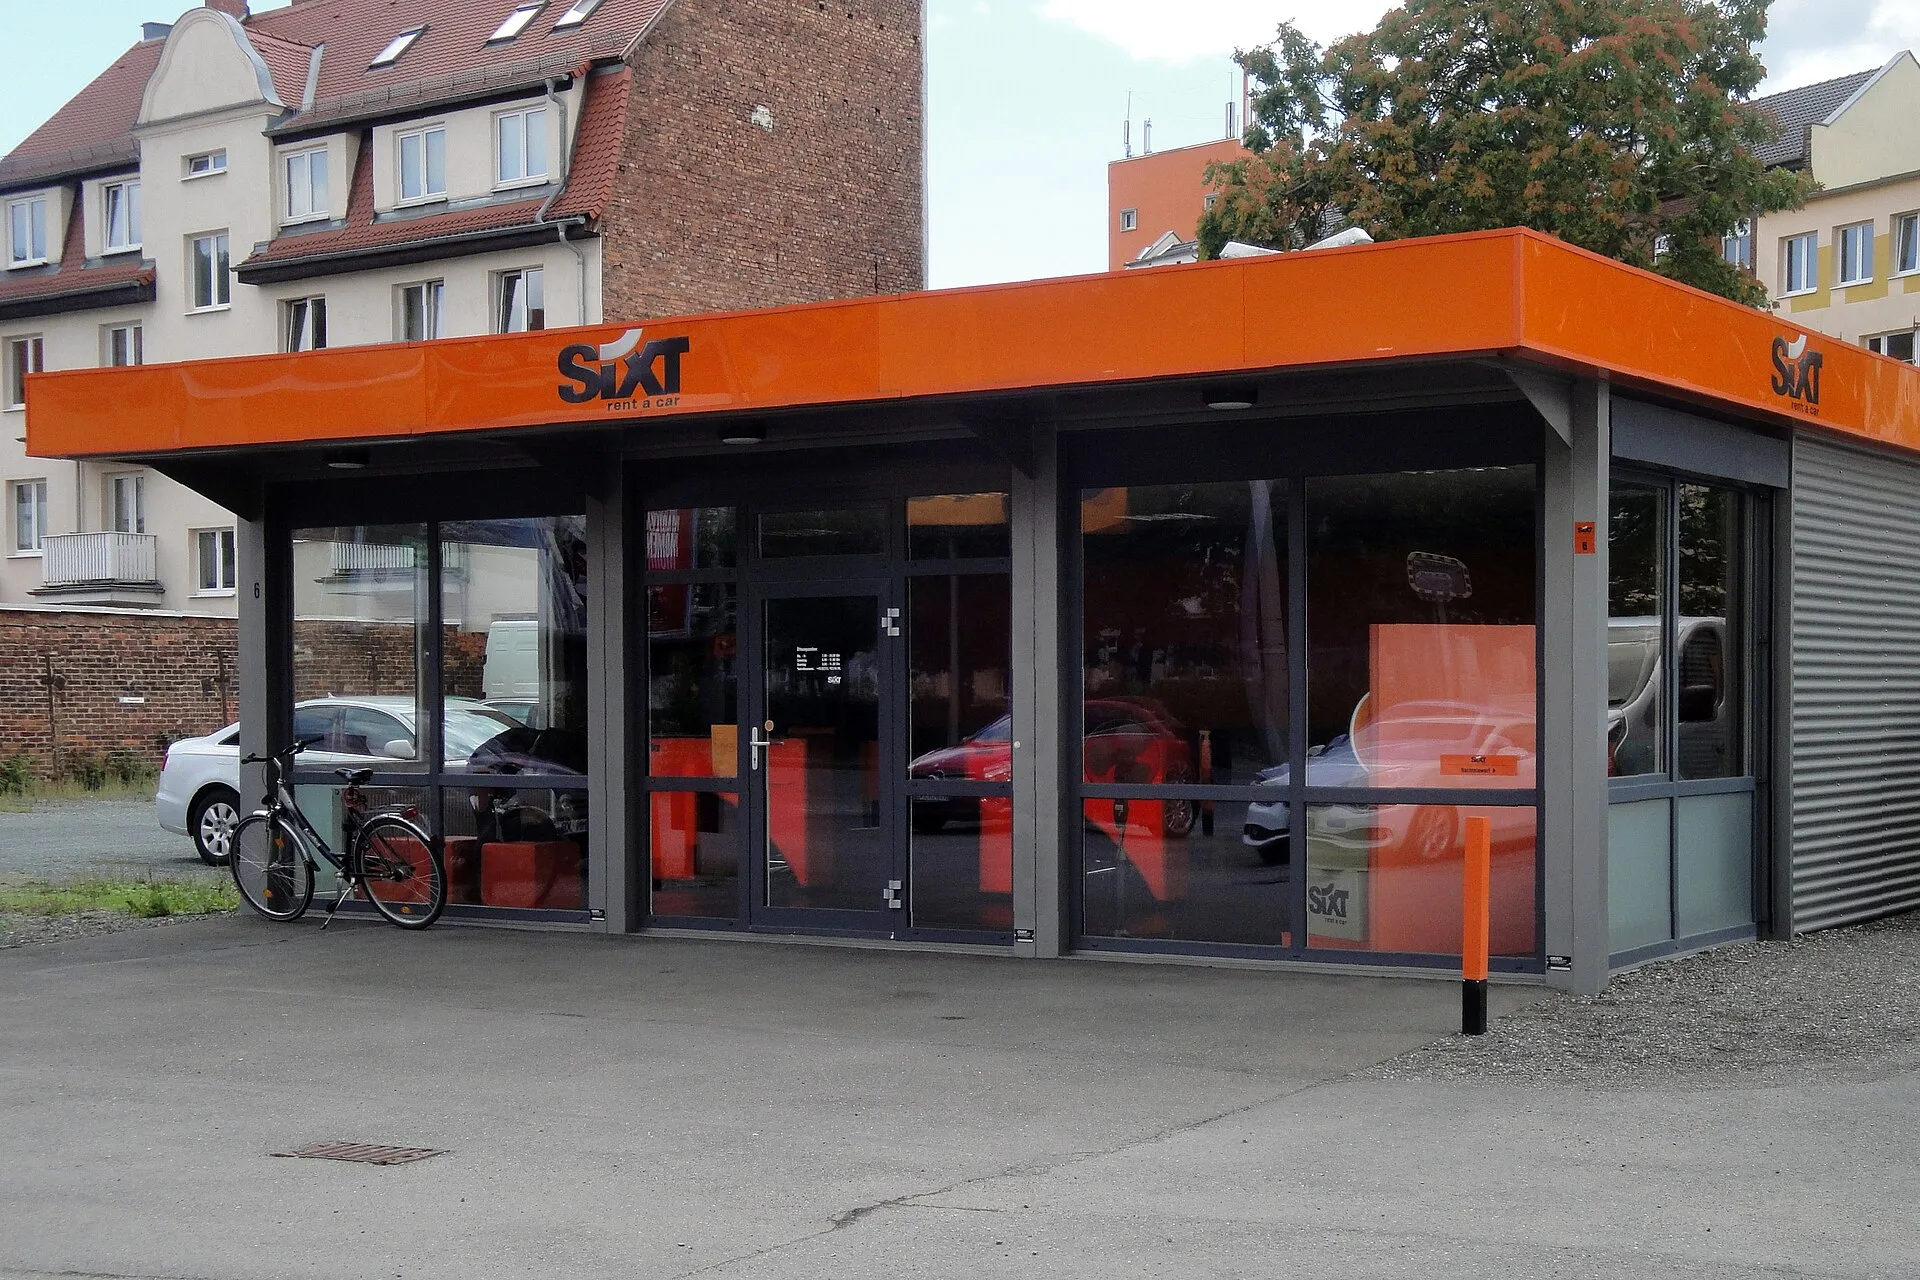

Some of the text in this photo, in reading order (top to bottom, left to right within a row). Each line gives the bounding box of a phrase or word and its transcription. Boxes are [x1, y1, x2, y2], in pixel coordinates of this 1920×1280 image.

[607, 397, 681, 411] rent a car
[1791, 401, 1804, 412] rent
[1810, 406, 1820, 416] car
[1582, 541, 1588, 551] 6
[254, 582, 261, 599] 6
